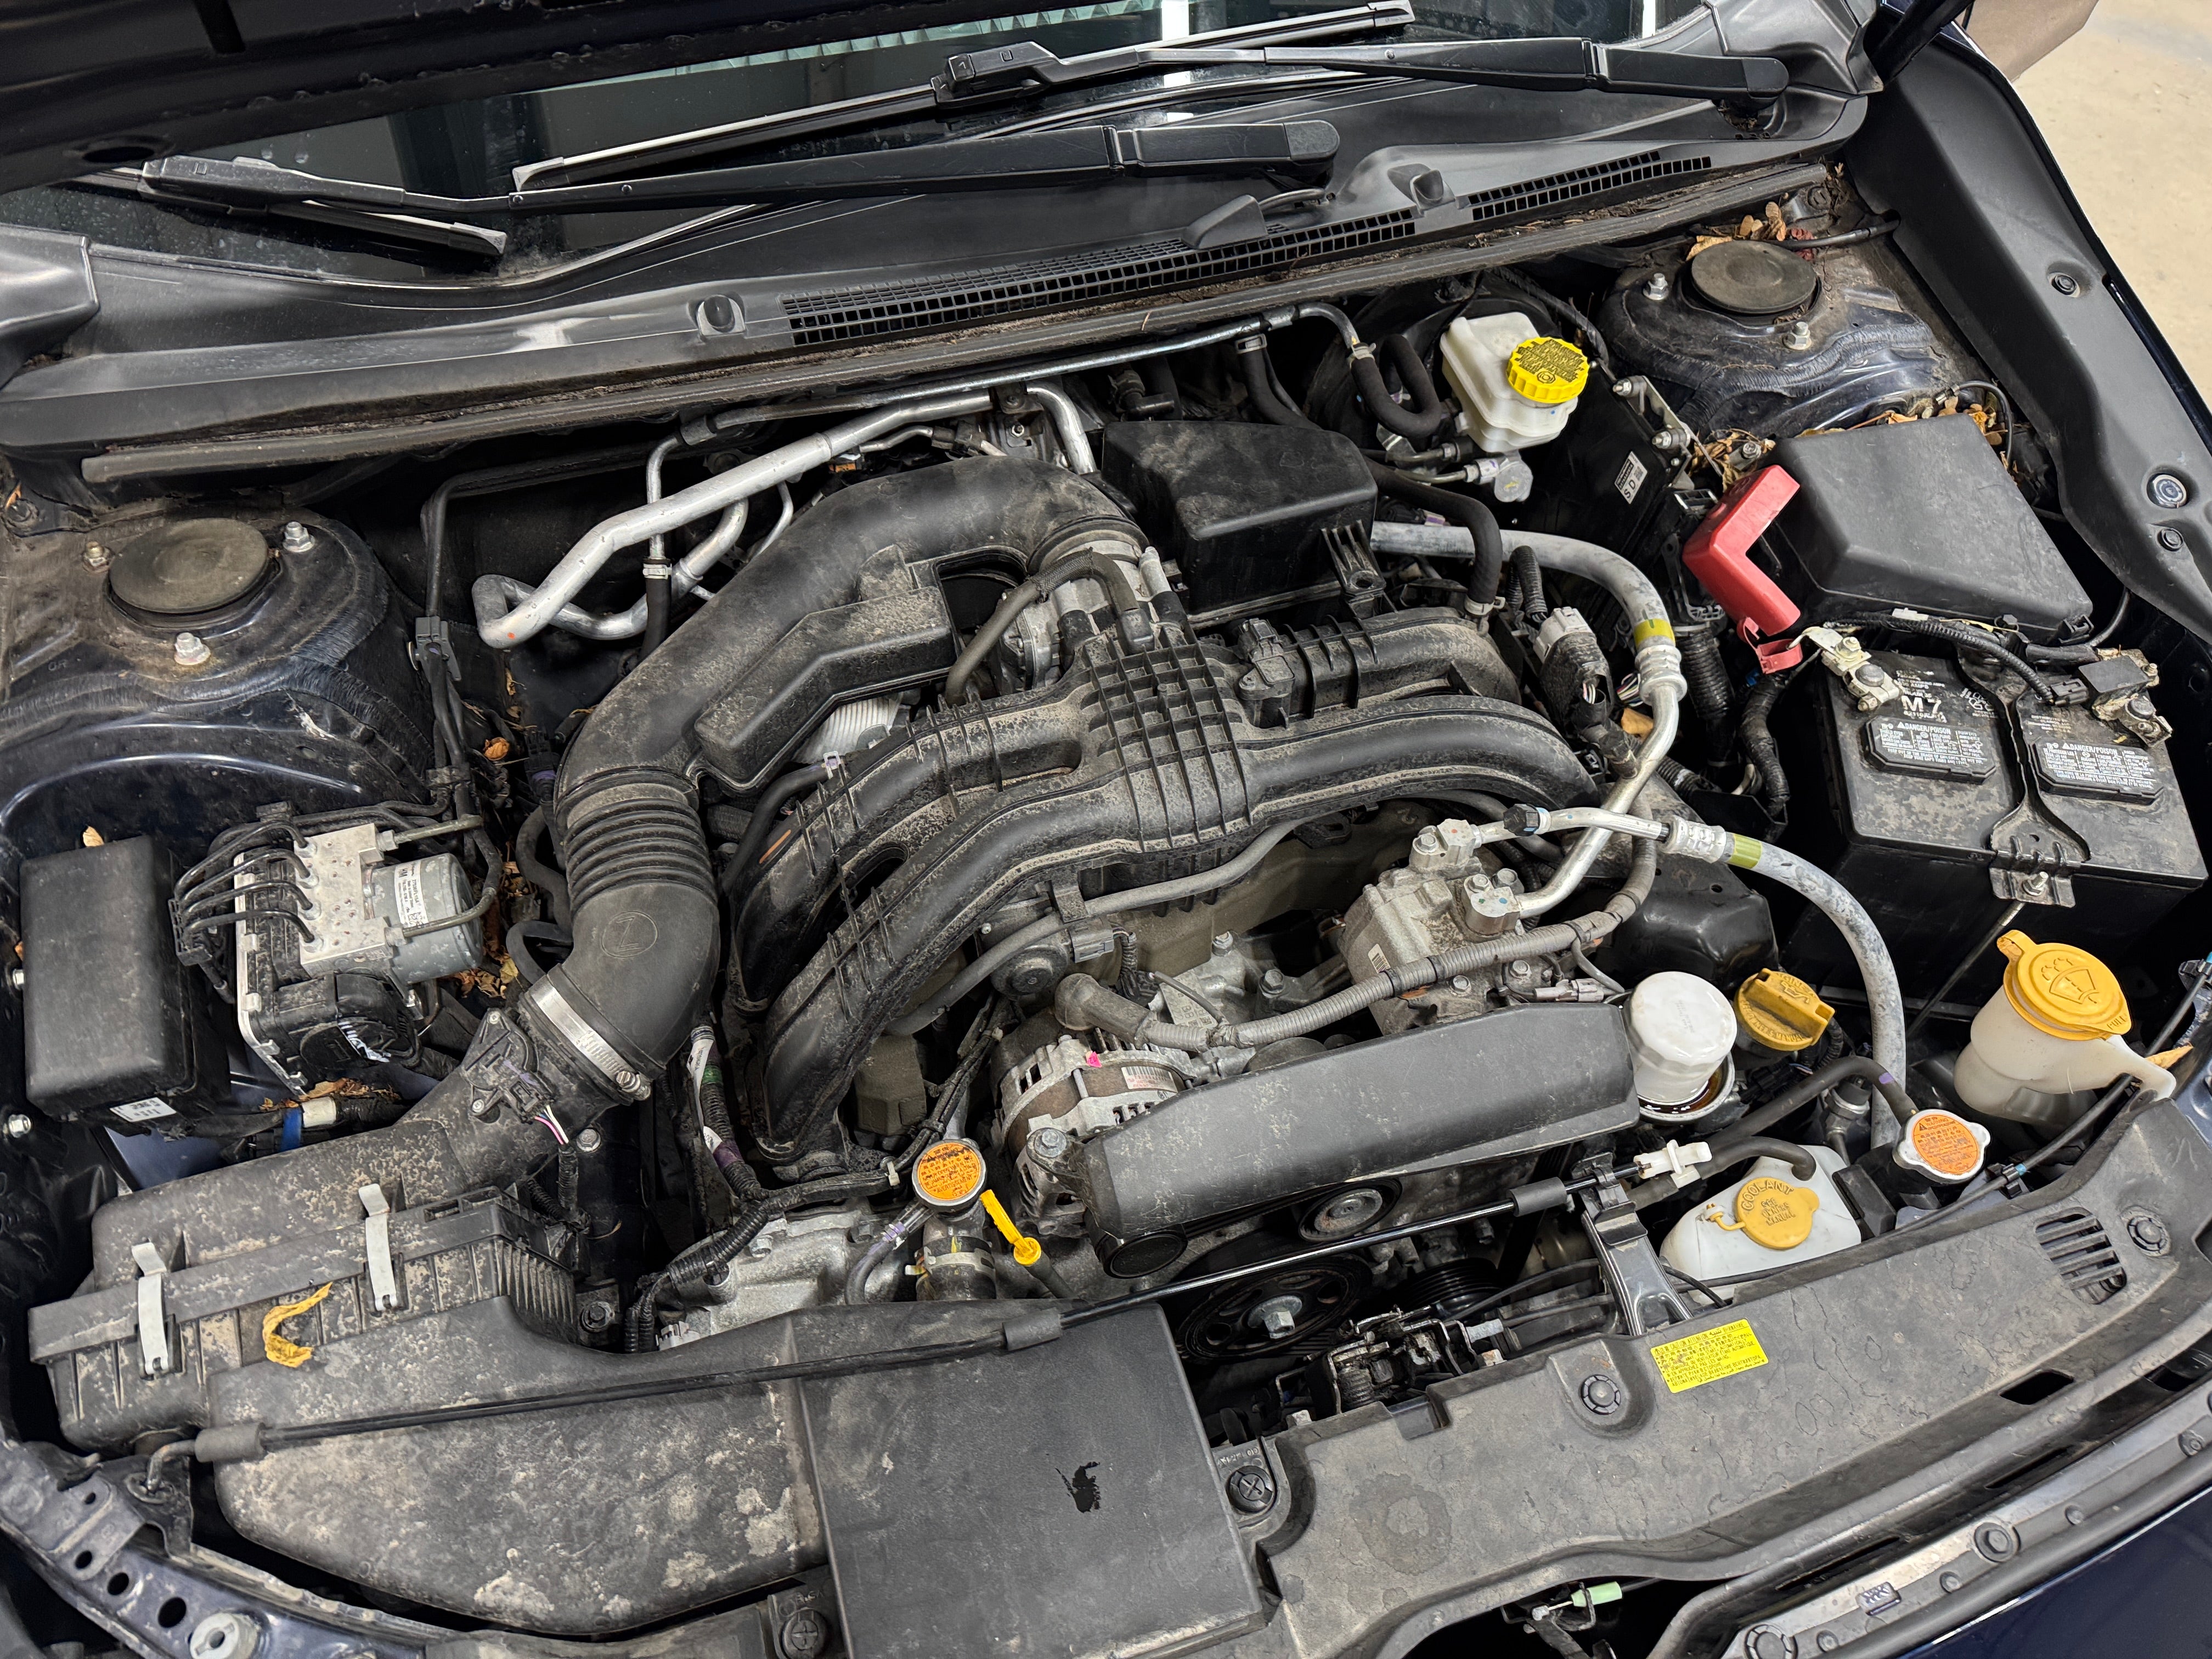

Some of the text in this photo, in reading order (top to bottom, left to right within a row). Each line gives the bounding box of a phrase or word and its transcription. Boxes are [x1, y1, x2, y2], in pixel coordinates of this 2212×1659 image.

[1904, 723, 1951, 734] DANGER/POISON
[2069, 743, 2117, 755] DANGER/POISON
[1776, 1032, 1804, 1042] MANUAL
[1741, 1179, 1795, 1211] COOLANT
[1760, 1198, 1777, 1209] SEE
[1765, 1211, 1796, 1226] MANUAL
[1669, 1340, 1687, 1350] CAUTION
